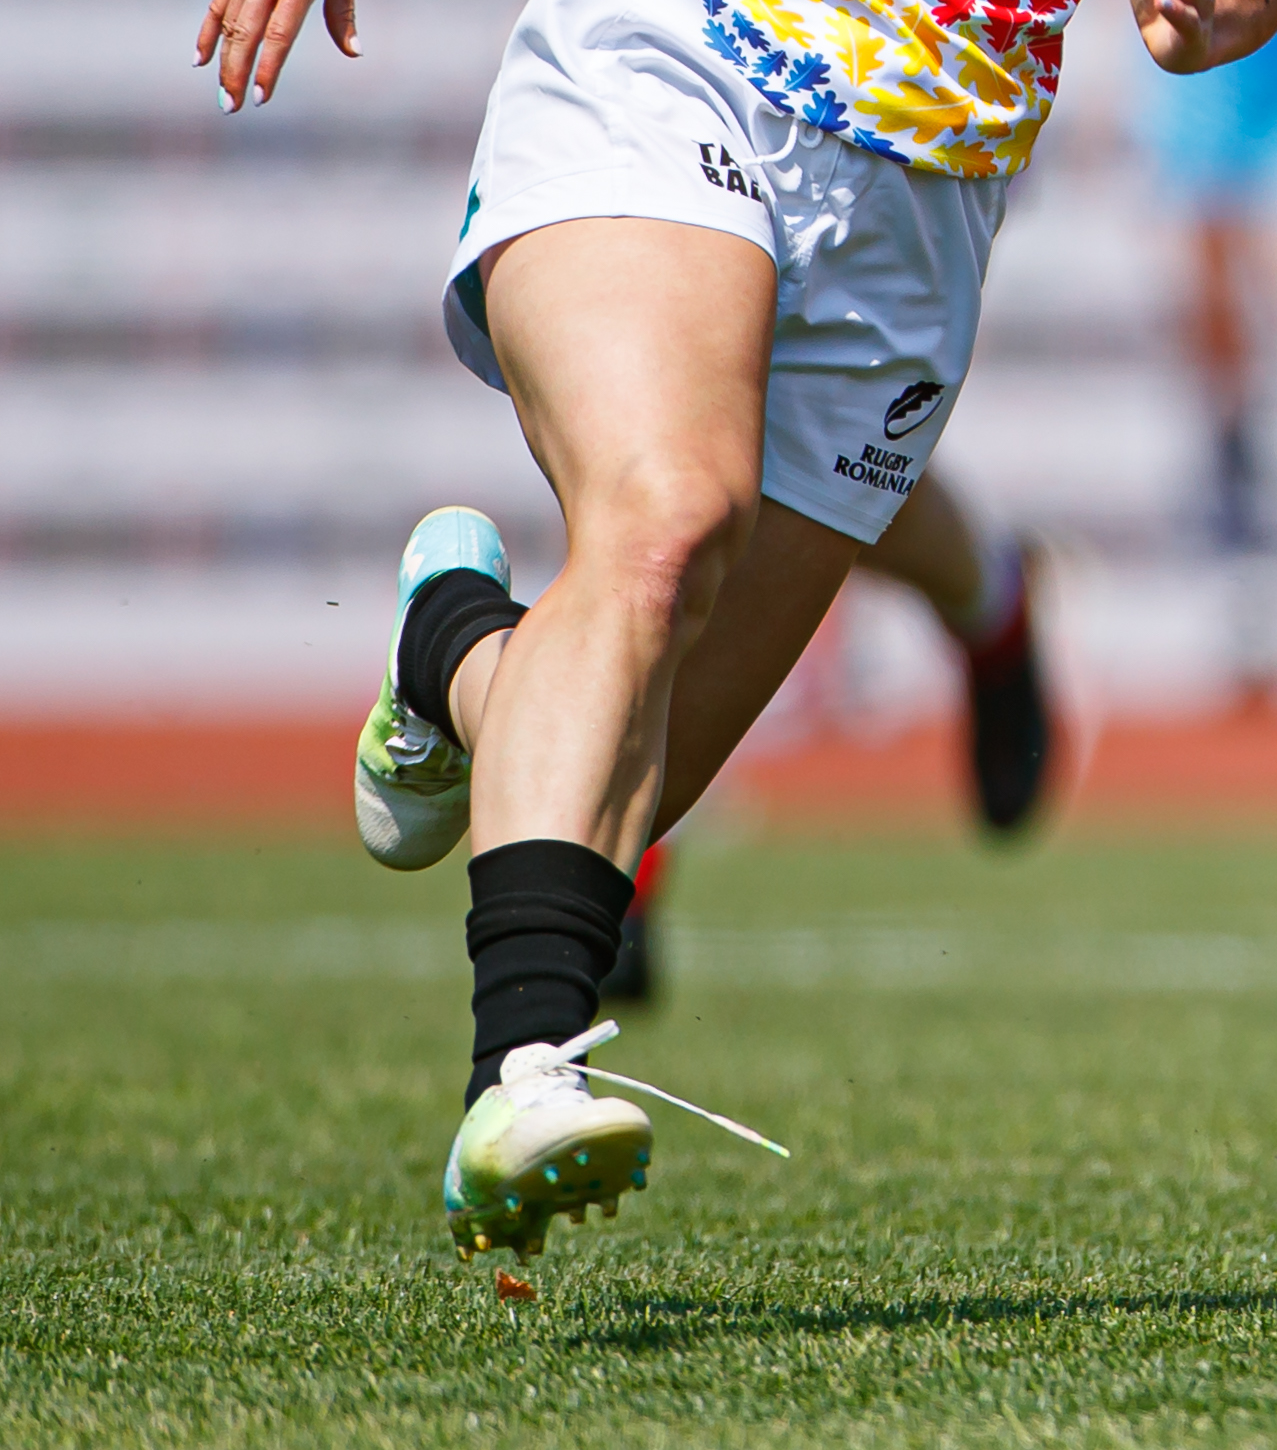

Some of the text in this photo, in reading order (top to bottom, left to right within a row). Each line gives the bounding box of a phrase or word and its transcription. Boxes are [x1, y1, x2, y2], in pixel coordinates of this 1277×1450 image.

[698, 142, 742, 169] TA
[860, 443, 914, 474] RUGBY
[833, 454, 915, 497] ROMANIA
